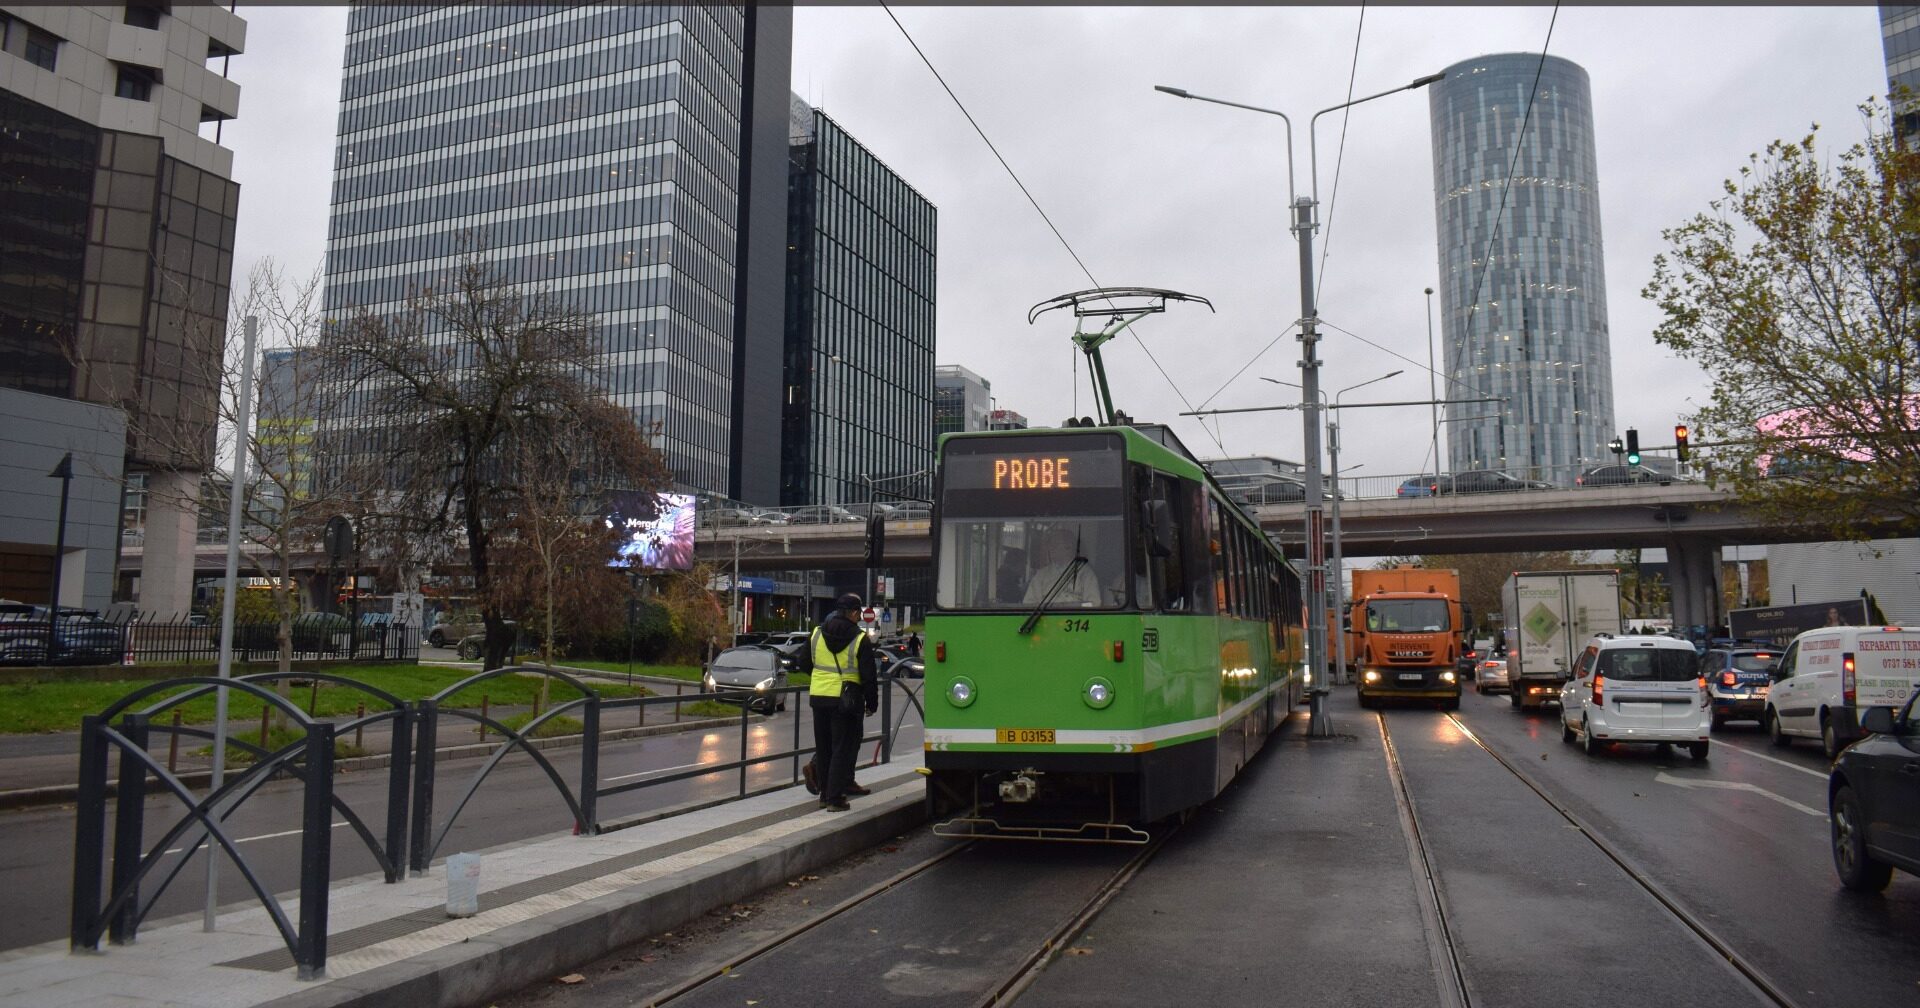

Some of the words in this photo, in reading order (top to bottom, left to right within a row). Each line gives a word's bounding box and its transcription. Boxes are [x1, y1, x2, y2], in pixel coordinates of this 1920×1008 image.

[995, 458, 1069, 488] PROBE
[1064, 619, 1090, 632] 314
[1142, 633, 1157, 647] STB
[1883, 659, 1900, 668] 0737
[1008, 731, 1016, 742] B
[1021, 731, 1054, 742] 03153
